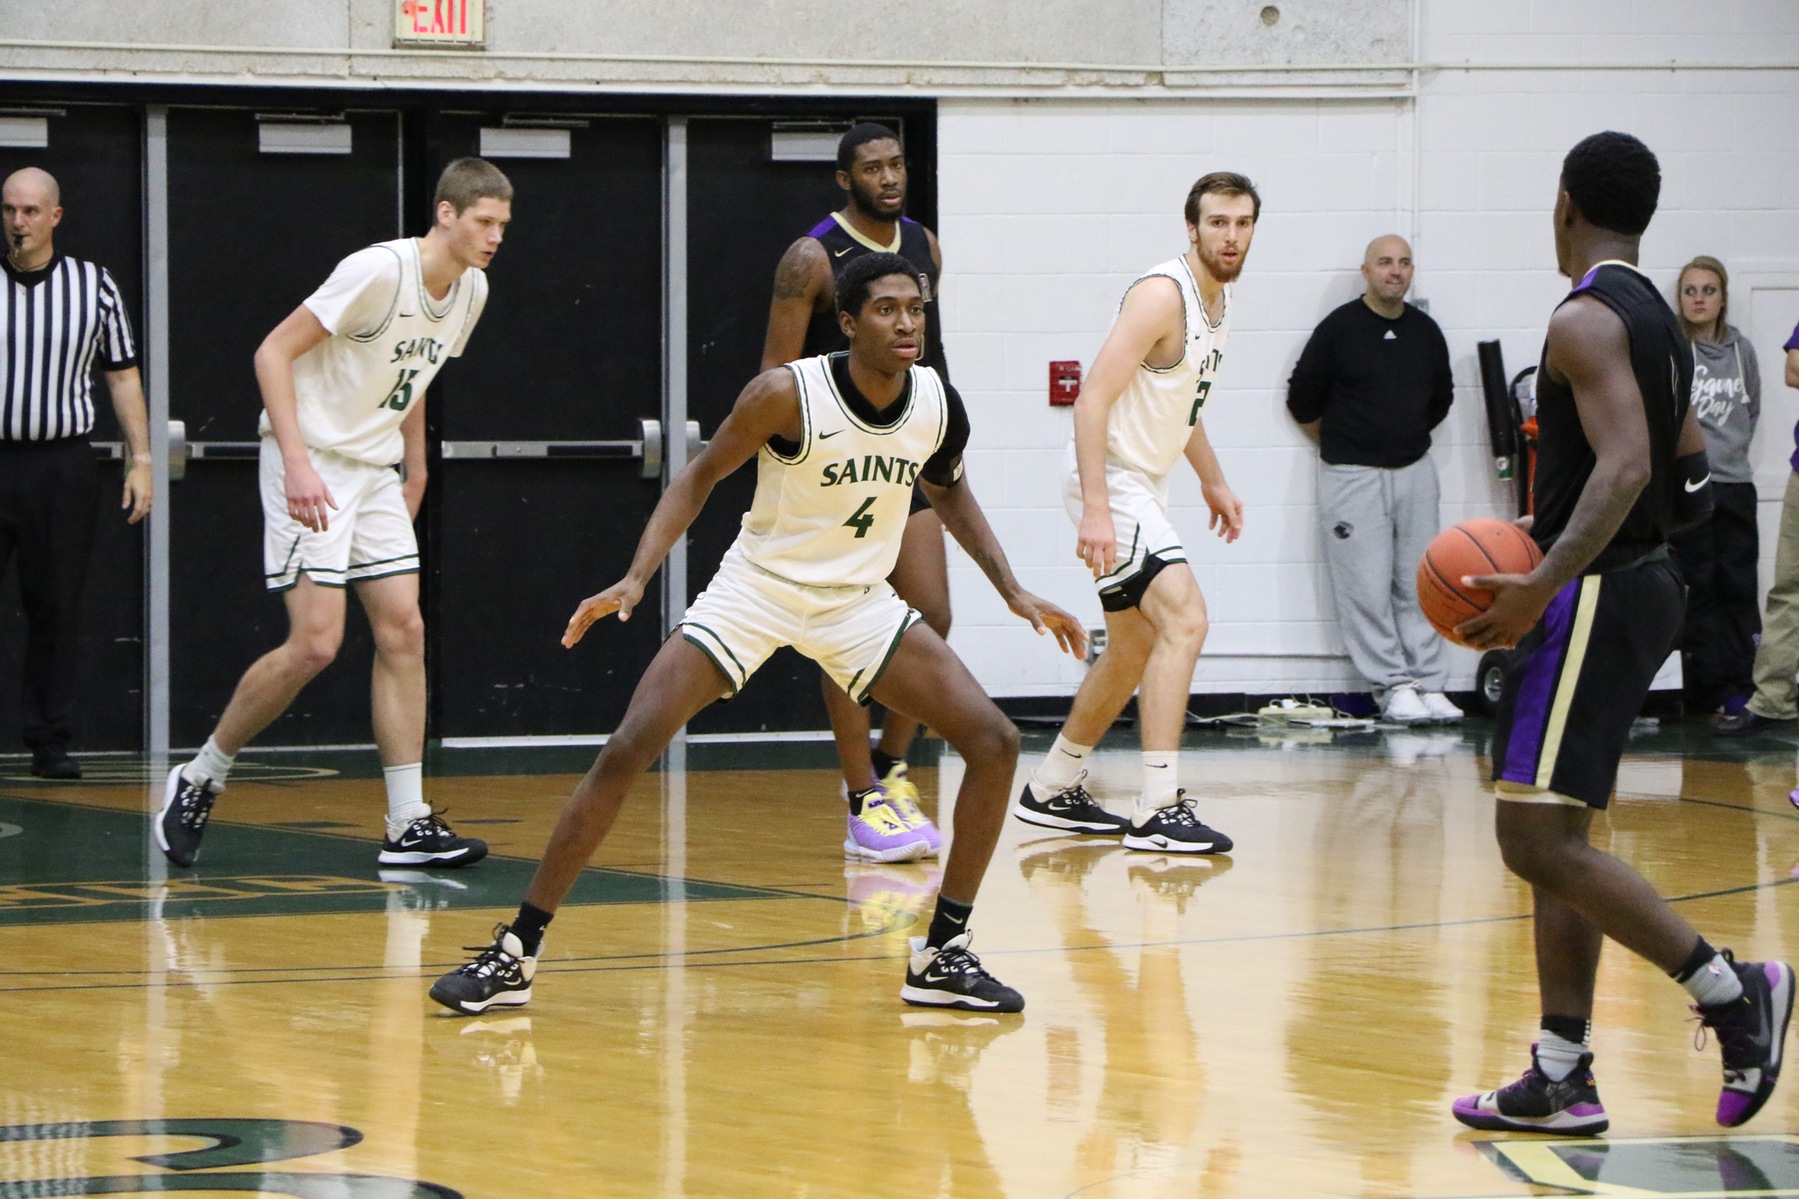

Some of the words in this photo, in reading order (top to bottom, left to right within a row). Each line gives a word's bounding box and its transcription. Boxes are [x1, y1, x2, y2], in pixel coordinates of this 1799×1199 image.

[378, 368, 420, 411] 15
[1697, 396, 1734, 427] Day
[820, 455, 919, 487] SAINTS
[842, 496, 878, 538] 4
